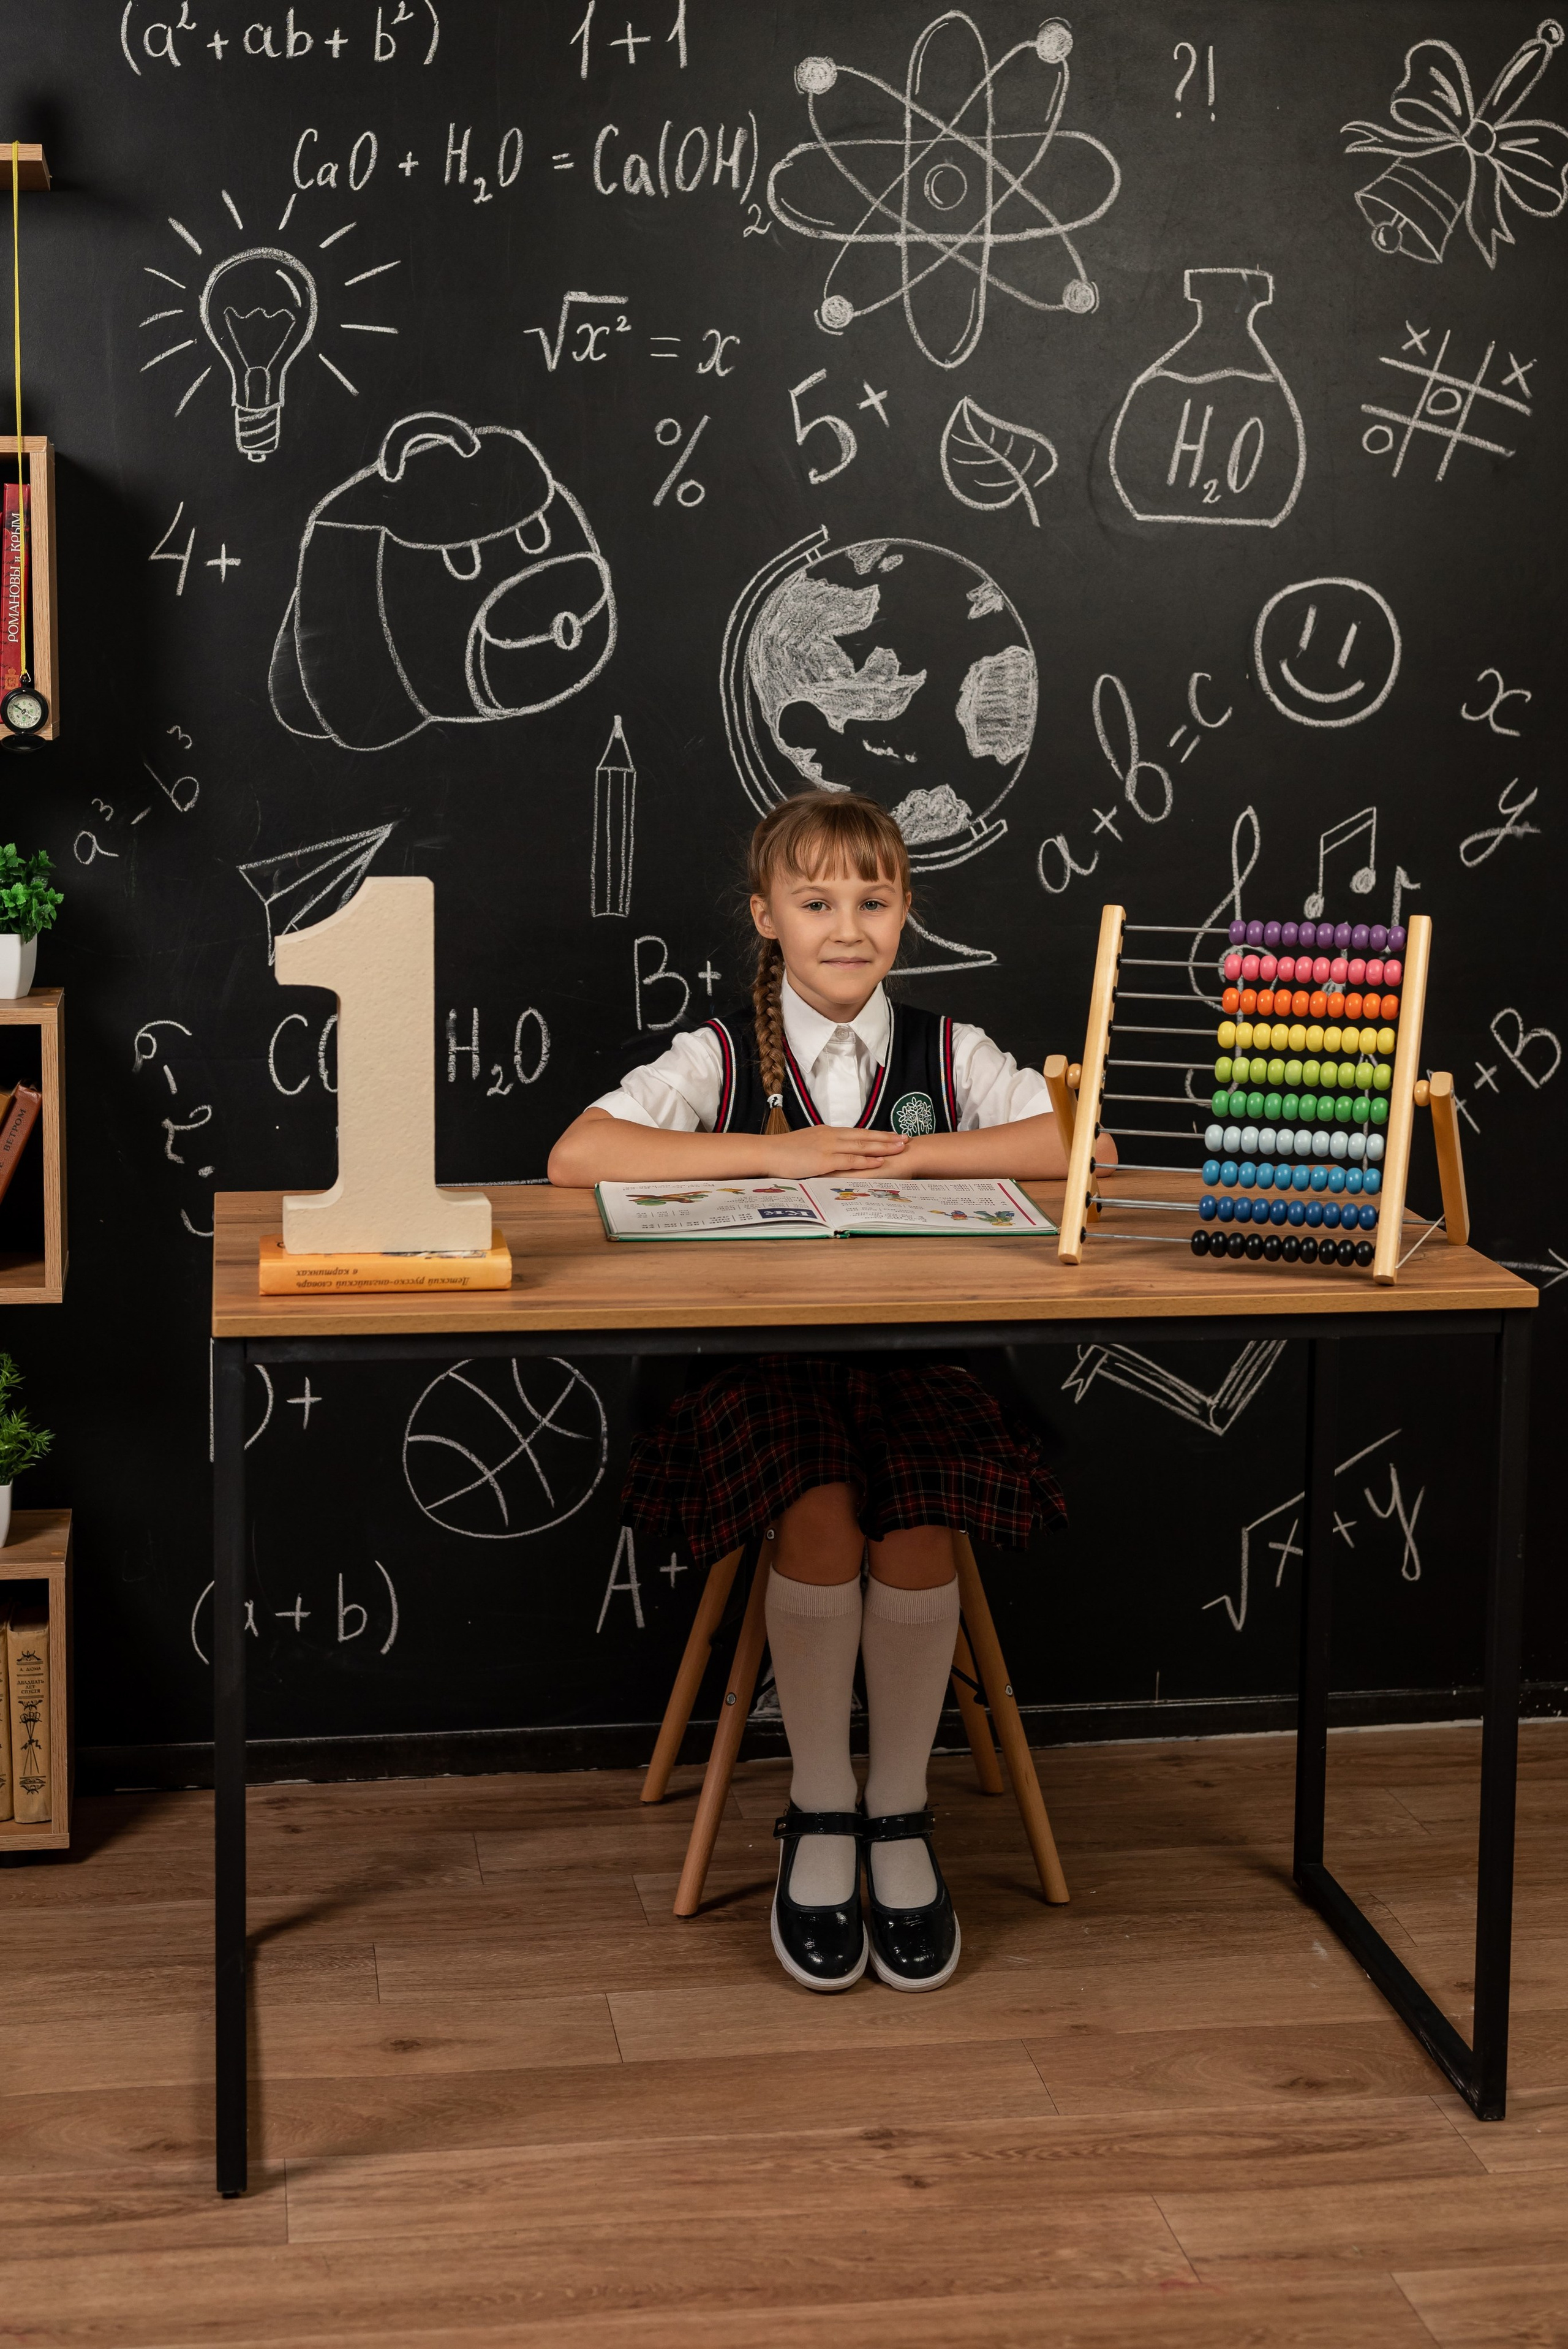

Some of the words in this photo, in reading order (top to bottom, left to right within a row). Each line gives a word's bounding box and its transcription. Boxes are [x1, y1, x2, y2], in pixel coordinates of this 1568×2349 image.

[293, 128, 378, 191] CaO
[8, 566, 21, 642] РОМАНОВЫ
[4, 1108, 26, 1152] ВЕТРОМ
[296, 1268, 349, 1276] картинках
[336, 1277, 425, 1287] русско-английский
[429, 1277, 470, 1285] Детский
